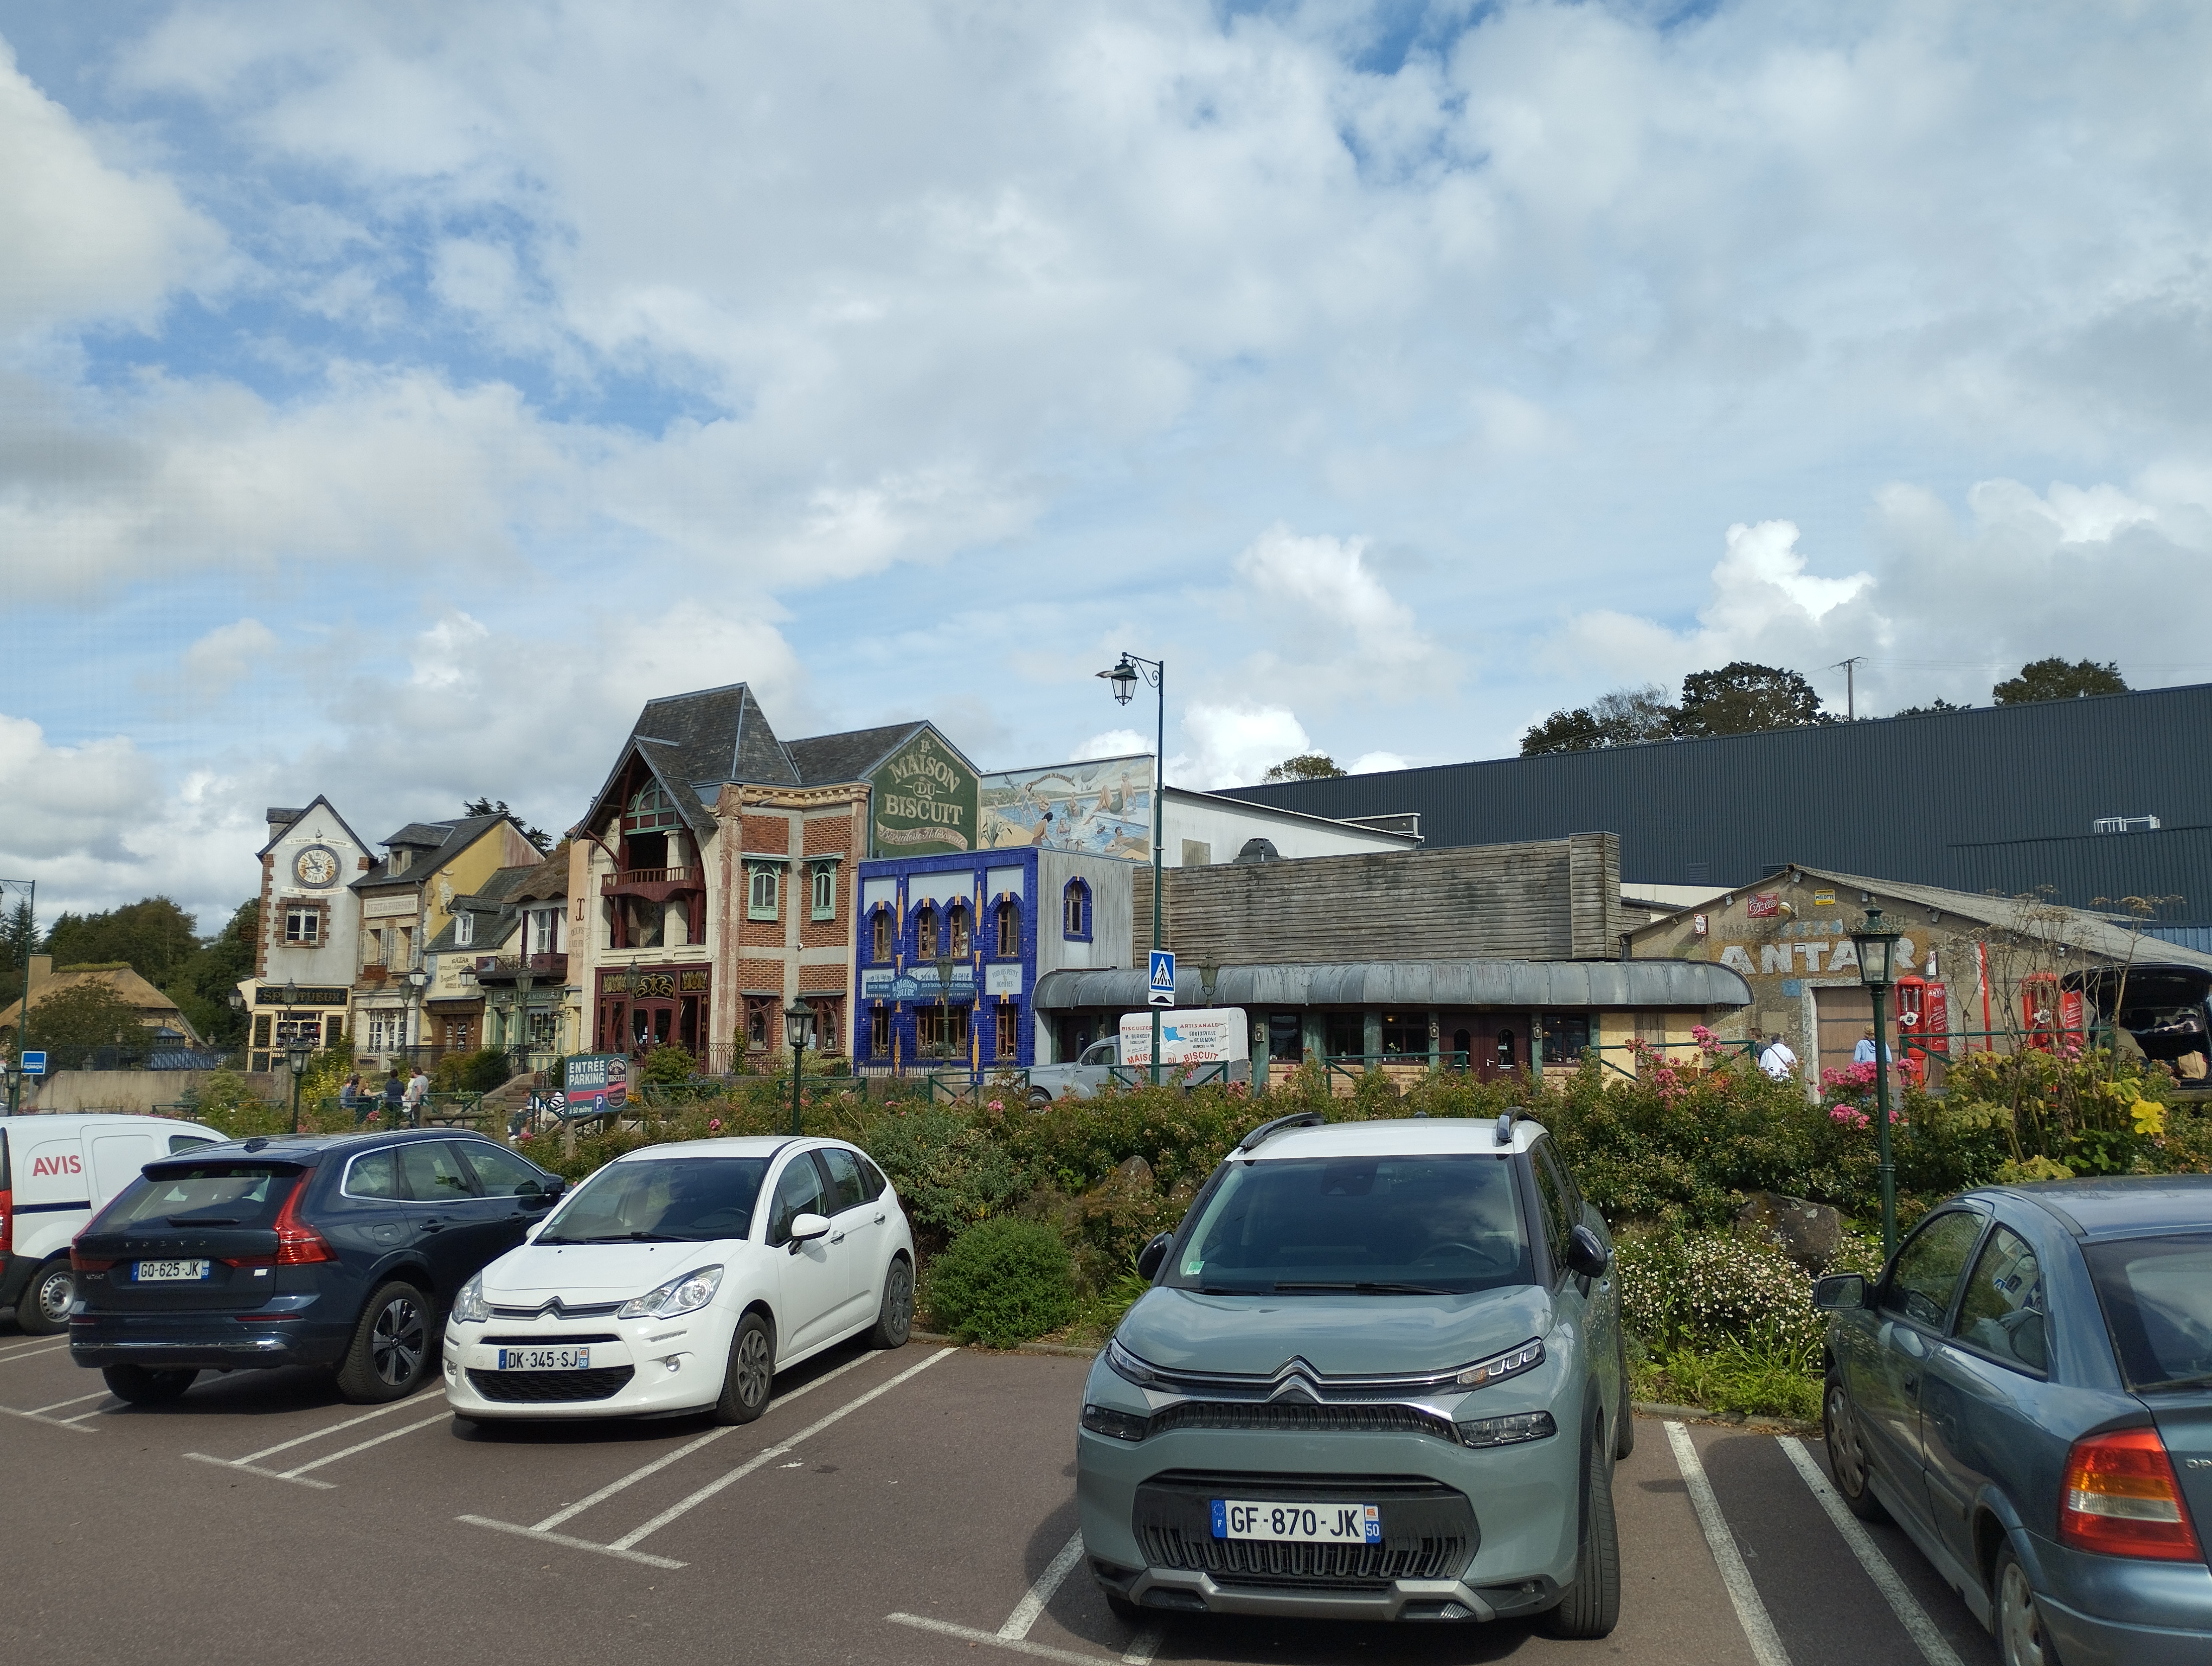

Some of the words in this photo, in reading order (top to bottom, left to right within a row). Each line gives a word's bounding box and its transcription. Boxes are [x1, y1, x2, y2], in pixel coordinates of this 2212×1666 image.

[888, 754, 960, 793] MAISON
[913, 780, 936, 798] DU
[884, 793, 963, 825] BISCUIT
[1719, 937, 1917, 975] ANTAR
[263, 992, 340, 1002] SPTUEUX
[569, 1057, 605, 1073] ENTRÉE
[1127, 1053, 1160, 1065] MAISO
[1184, 1051, 1219, 1062] BISCUIT
[569, 1072, 605, 1086] PARKING
[596, 1095, 603, 1110] P
[33, 1155, 81, 1176] AVIS
[1231, 1506, 1360, 1537] GF-870-JK
[1365, 1523, 1380, 1537] 50
